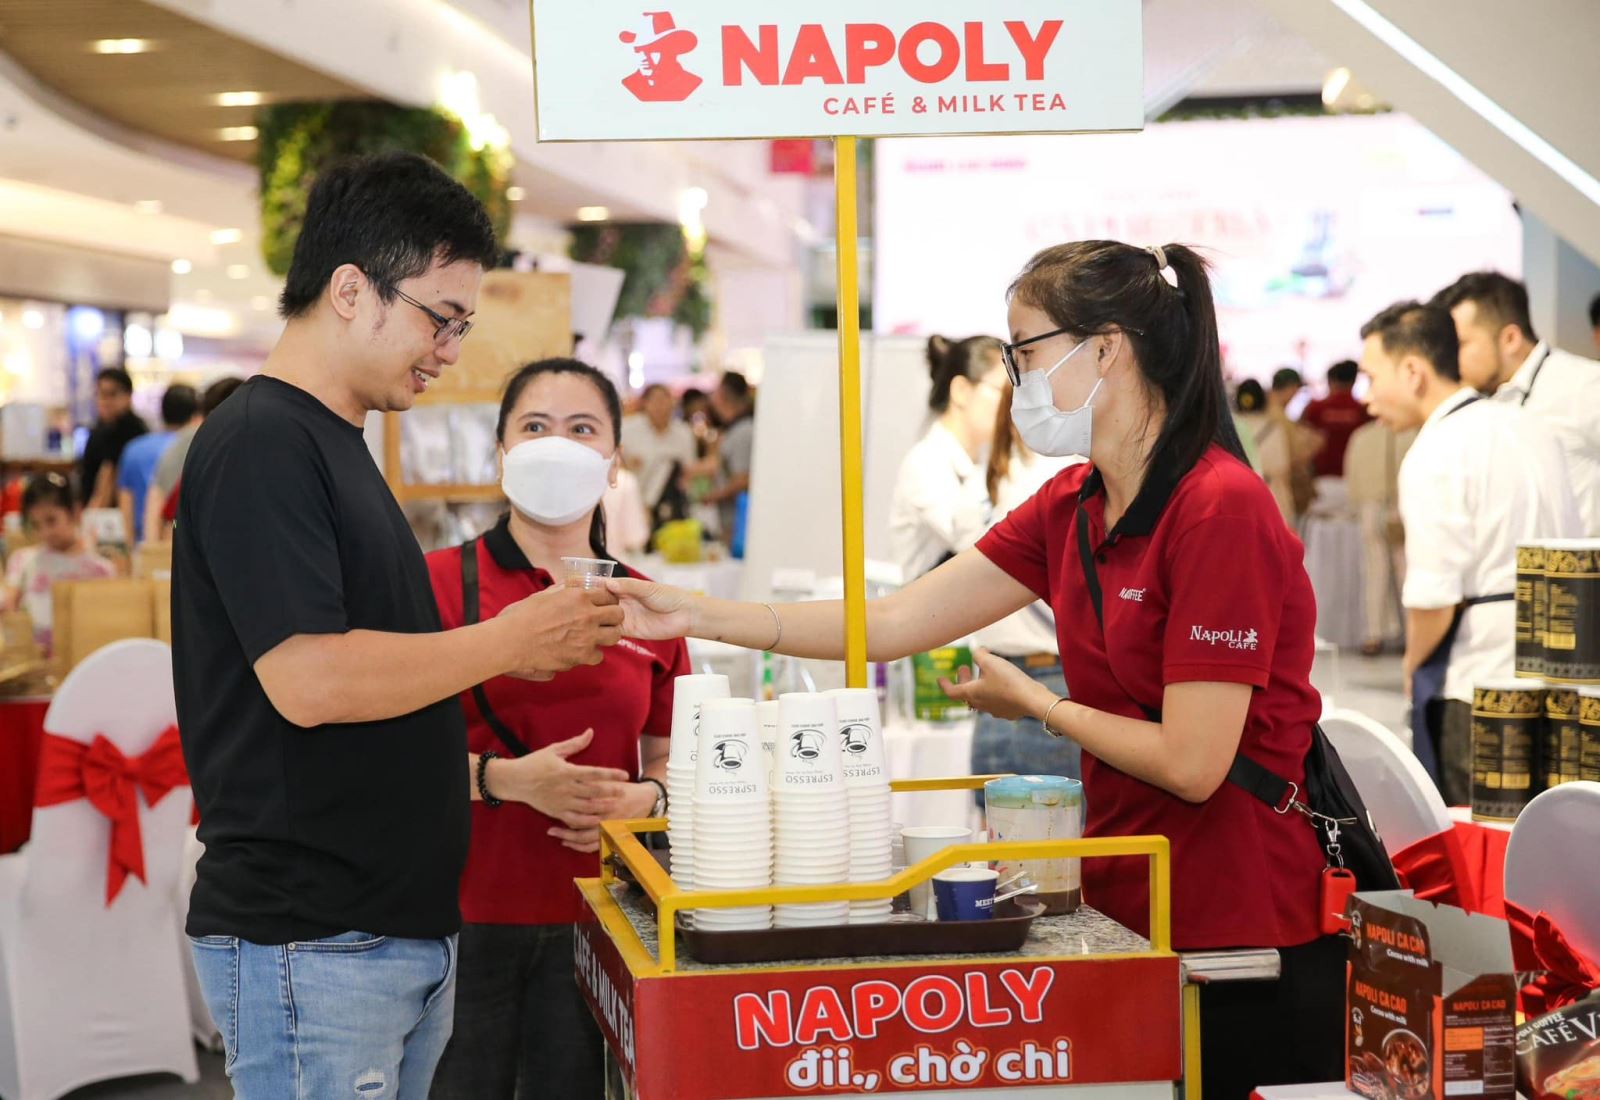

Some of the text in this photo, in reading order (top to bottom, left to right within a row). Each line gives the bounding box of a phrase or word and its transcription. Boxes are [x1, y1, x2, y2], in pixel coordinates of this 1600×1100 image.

[721, 20, 1064, 86] NAPOLY
[823, 93, 1067, 115] CAFÉ & MILK TEA
[785, 774, 833, 784] ESPRESSO
[842, 766, 880, 778] ESPRESS
[708, 784, 757, 795] ESPRESSO
[1367, 922, 1395, 946] NAPOLI
[599, 961, 619, 1040] MILK
[1355, 980, 1377, 1004] NAPOLI
[733, 966, 1055, 1050] NAPOLY
[1567, 1011, 1600, 1040] V
[890, 1041, 987, 1083] chờ
[997, 1040, 1069, 1080] chi
